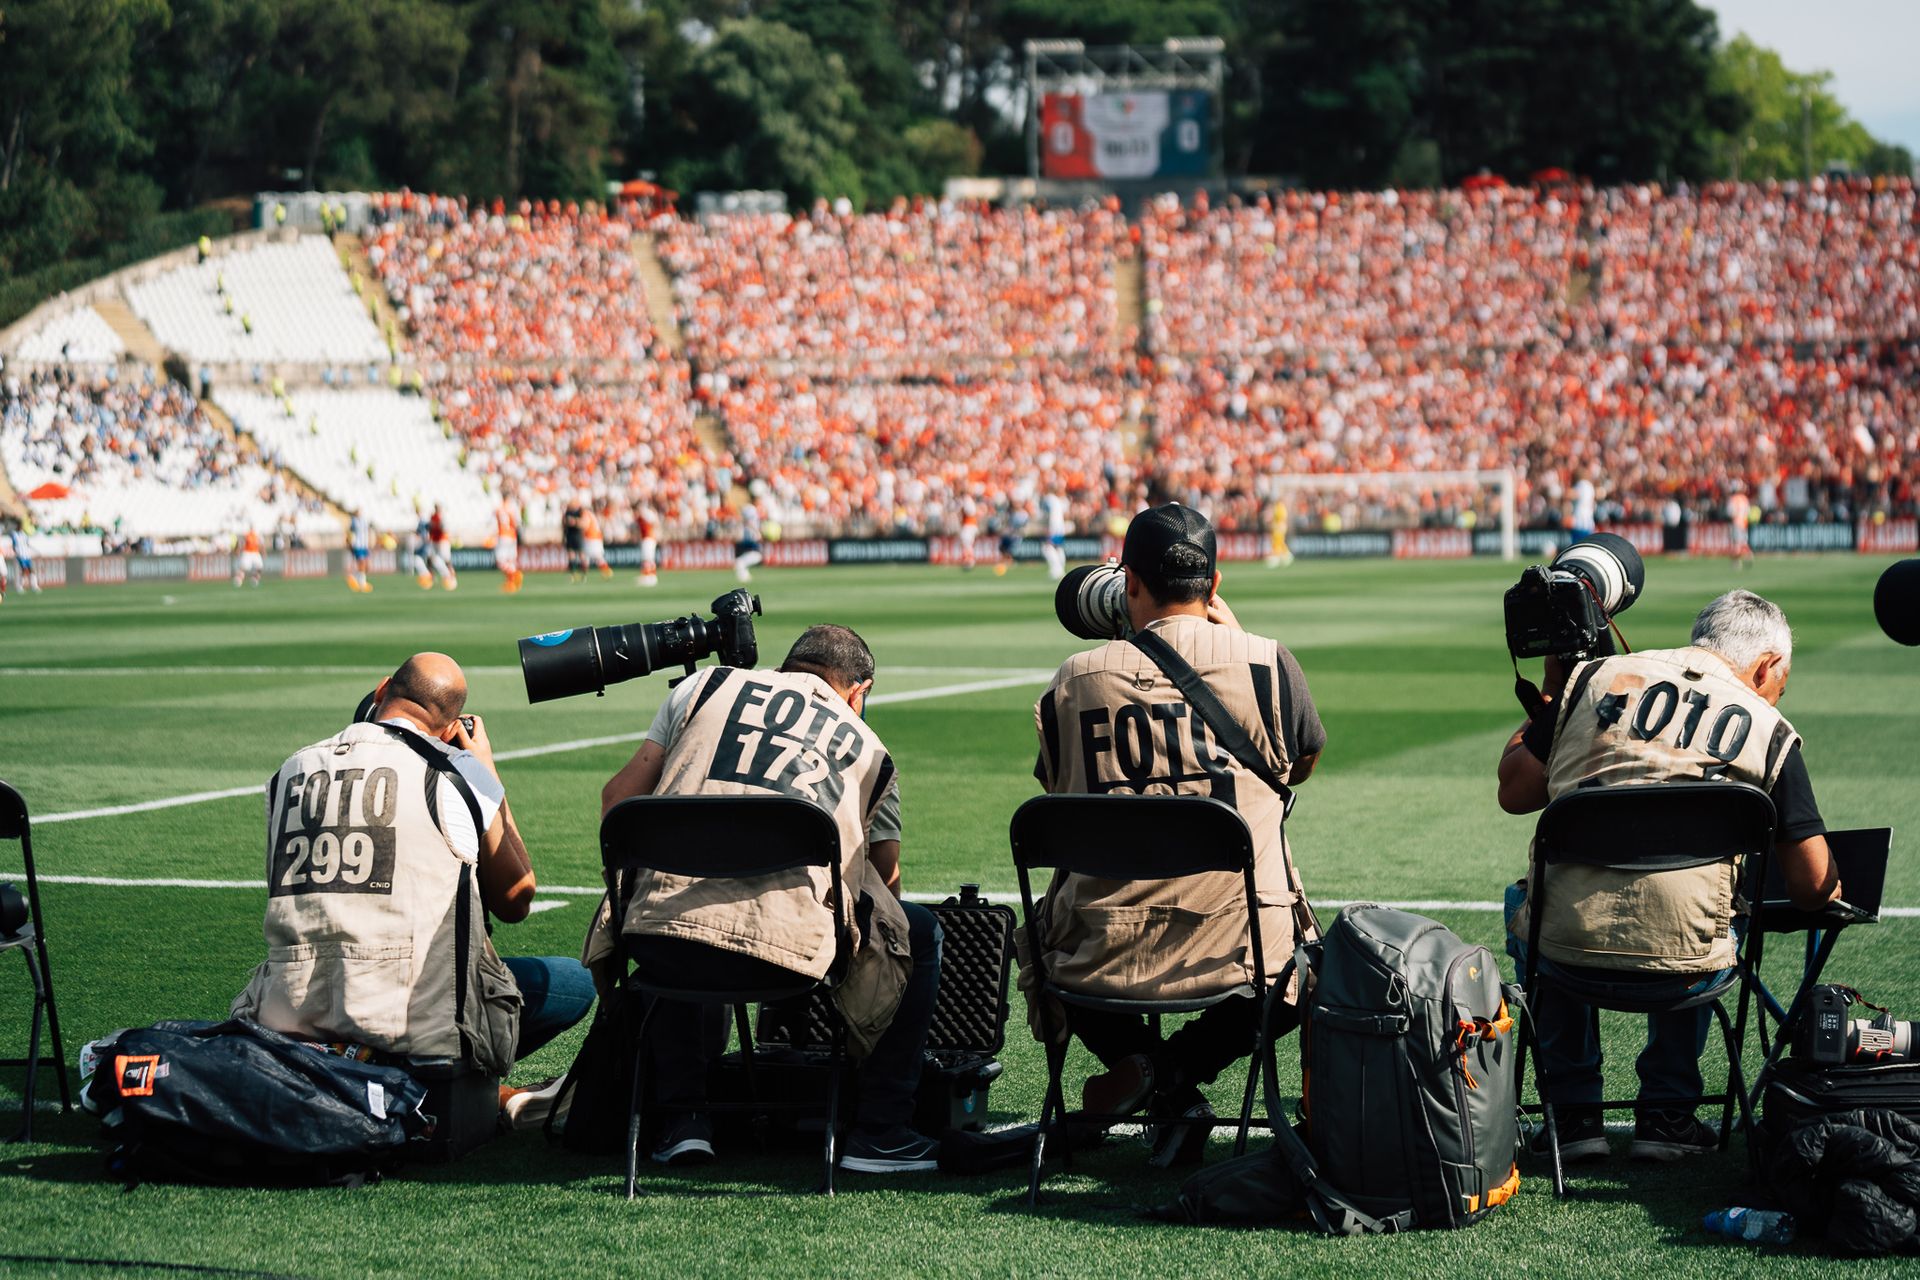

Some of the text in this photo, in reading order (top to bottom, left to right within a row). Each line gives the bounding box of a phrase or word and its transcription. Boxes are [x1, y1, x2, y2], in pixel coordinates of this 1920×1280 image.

[727, 680, 863, 772] FOTO
[281, 767, 398, 831] FOTO
[735, 730, 830, 801] 172
[281, 832, 374, 885] 299
